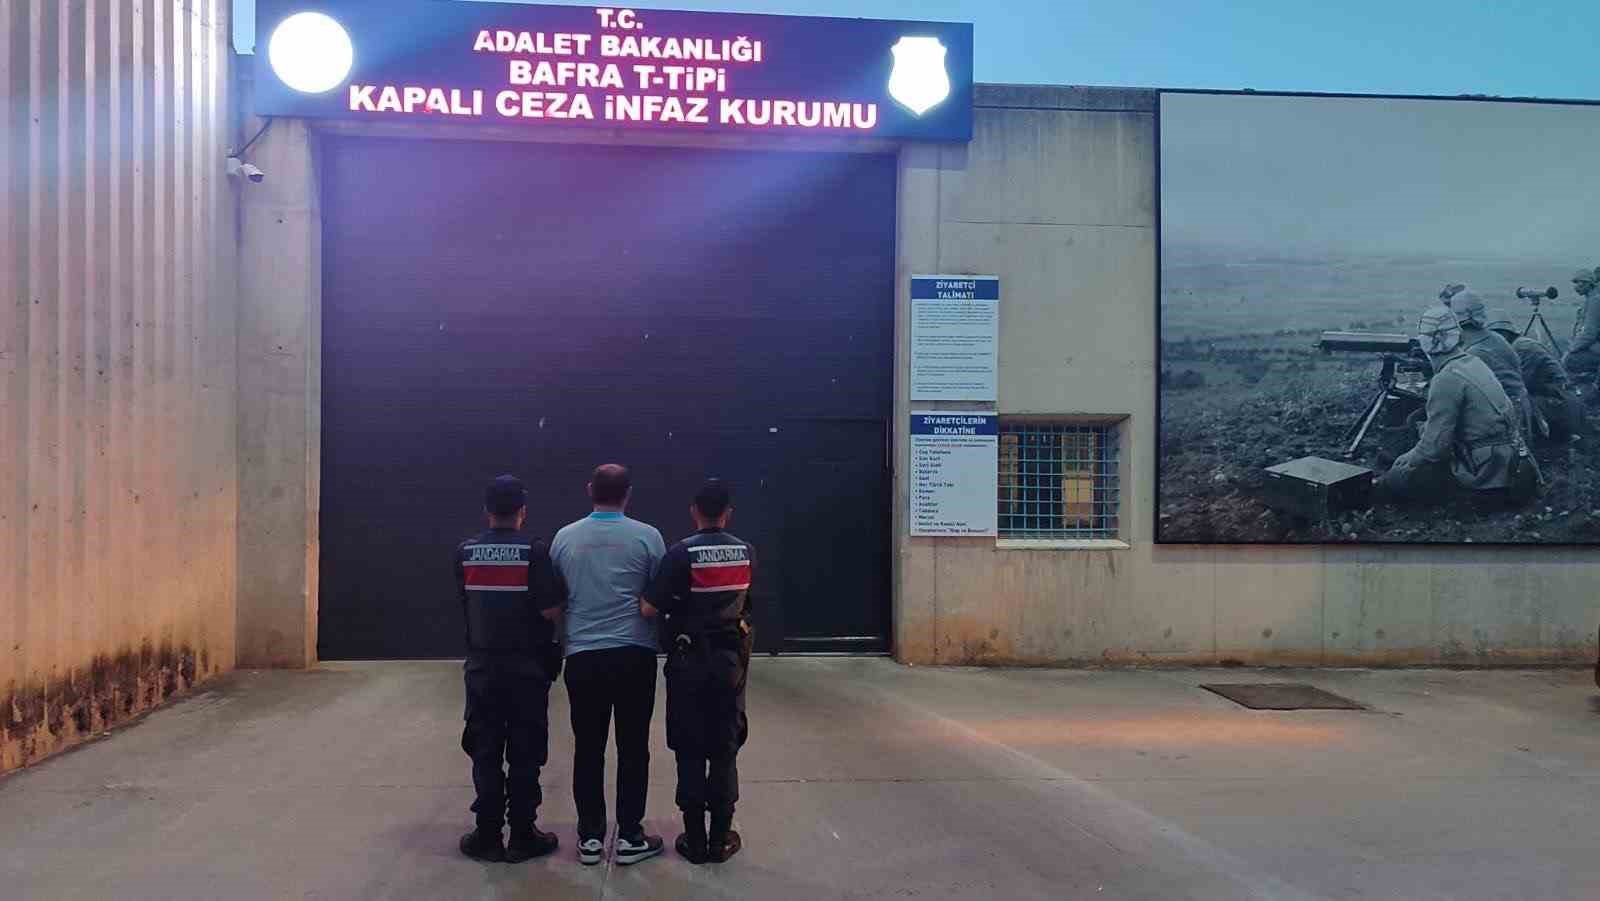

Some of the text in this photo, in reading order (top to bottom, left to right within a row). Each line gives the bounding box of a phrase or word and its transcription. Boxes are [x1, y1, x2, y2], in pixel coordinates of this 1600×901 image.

[596, 8, 643, 29] T.C.
[473, 30, 762, 62] ADALET BAKANLIĞI
[509, 60, 624, 89] BAFRA
[349, 84, 483, 115] KAPALI
[495, 90, 594, 119] CEZA
[720, 98, 877, 129] KURUMU
[469, 547, 521, 561] JANDARMA
[696, 548, 747, 562] JANDARMA
